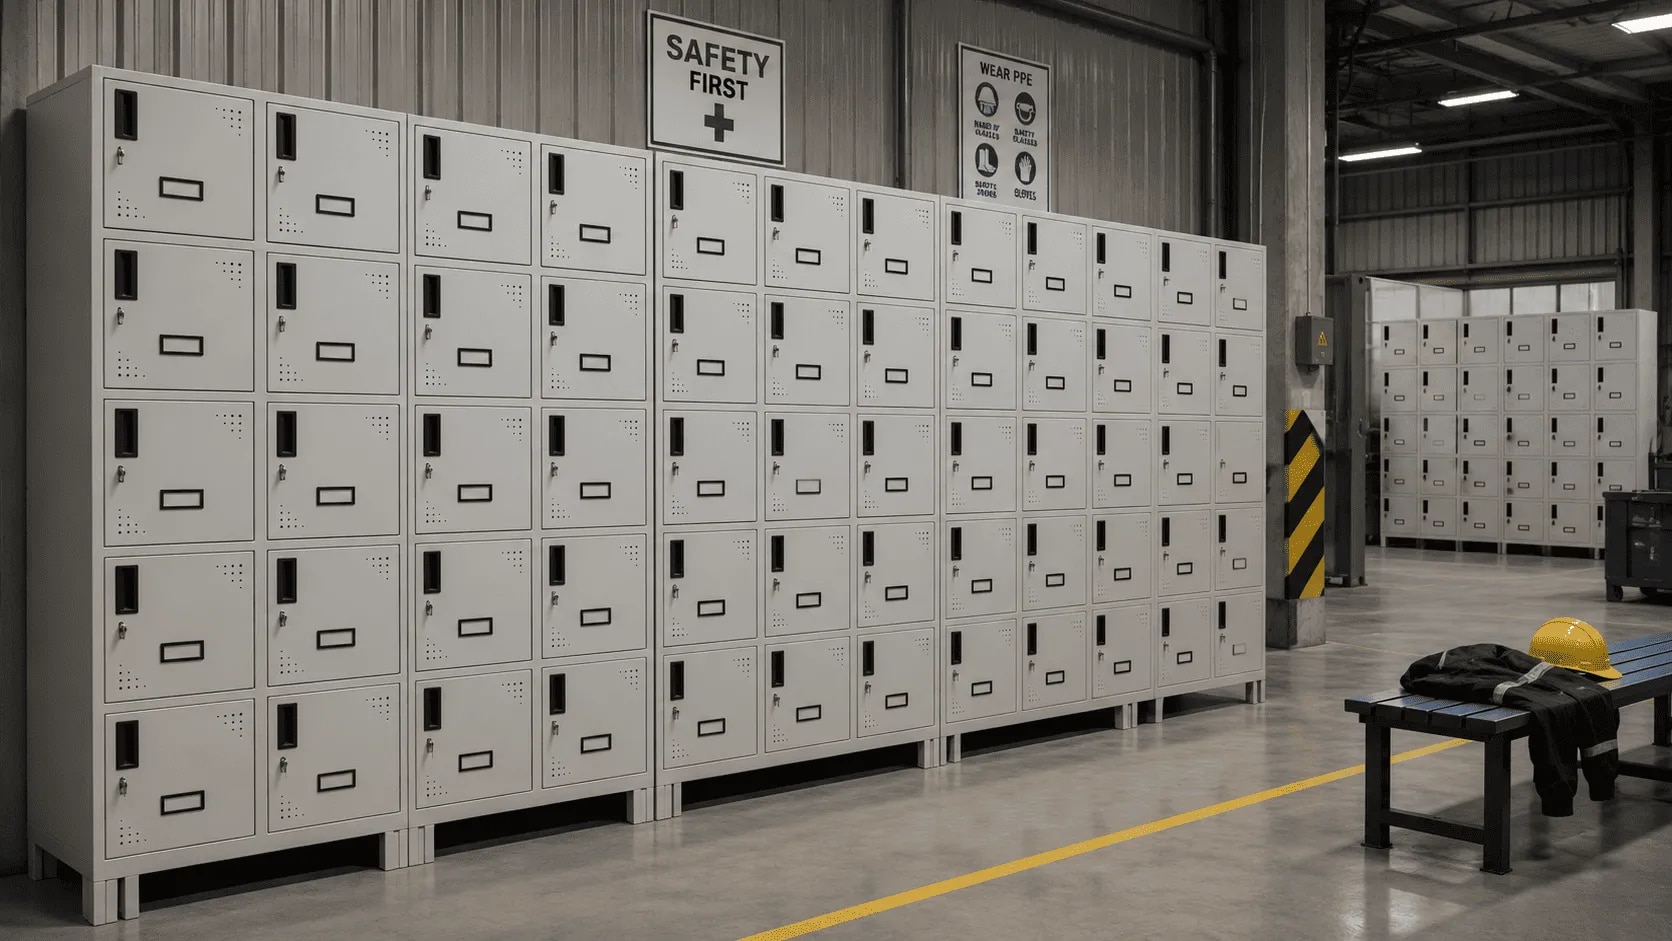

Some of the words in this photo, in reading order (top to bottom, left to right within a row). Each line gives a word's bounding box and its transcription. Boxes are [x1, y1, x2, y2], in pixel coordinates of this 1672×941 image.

[666, 34, 770, 78] SAFETY
[690, 70, 748, 100] FIRST
[980, 61, 1010, 81] WEAR
[1013, 69, 1033, 87] PPE
